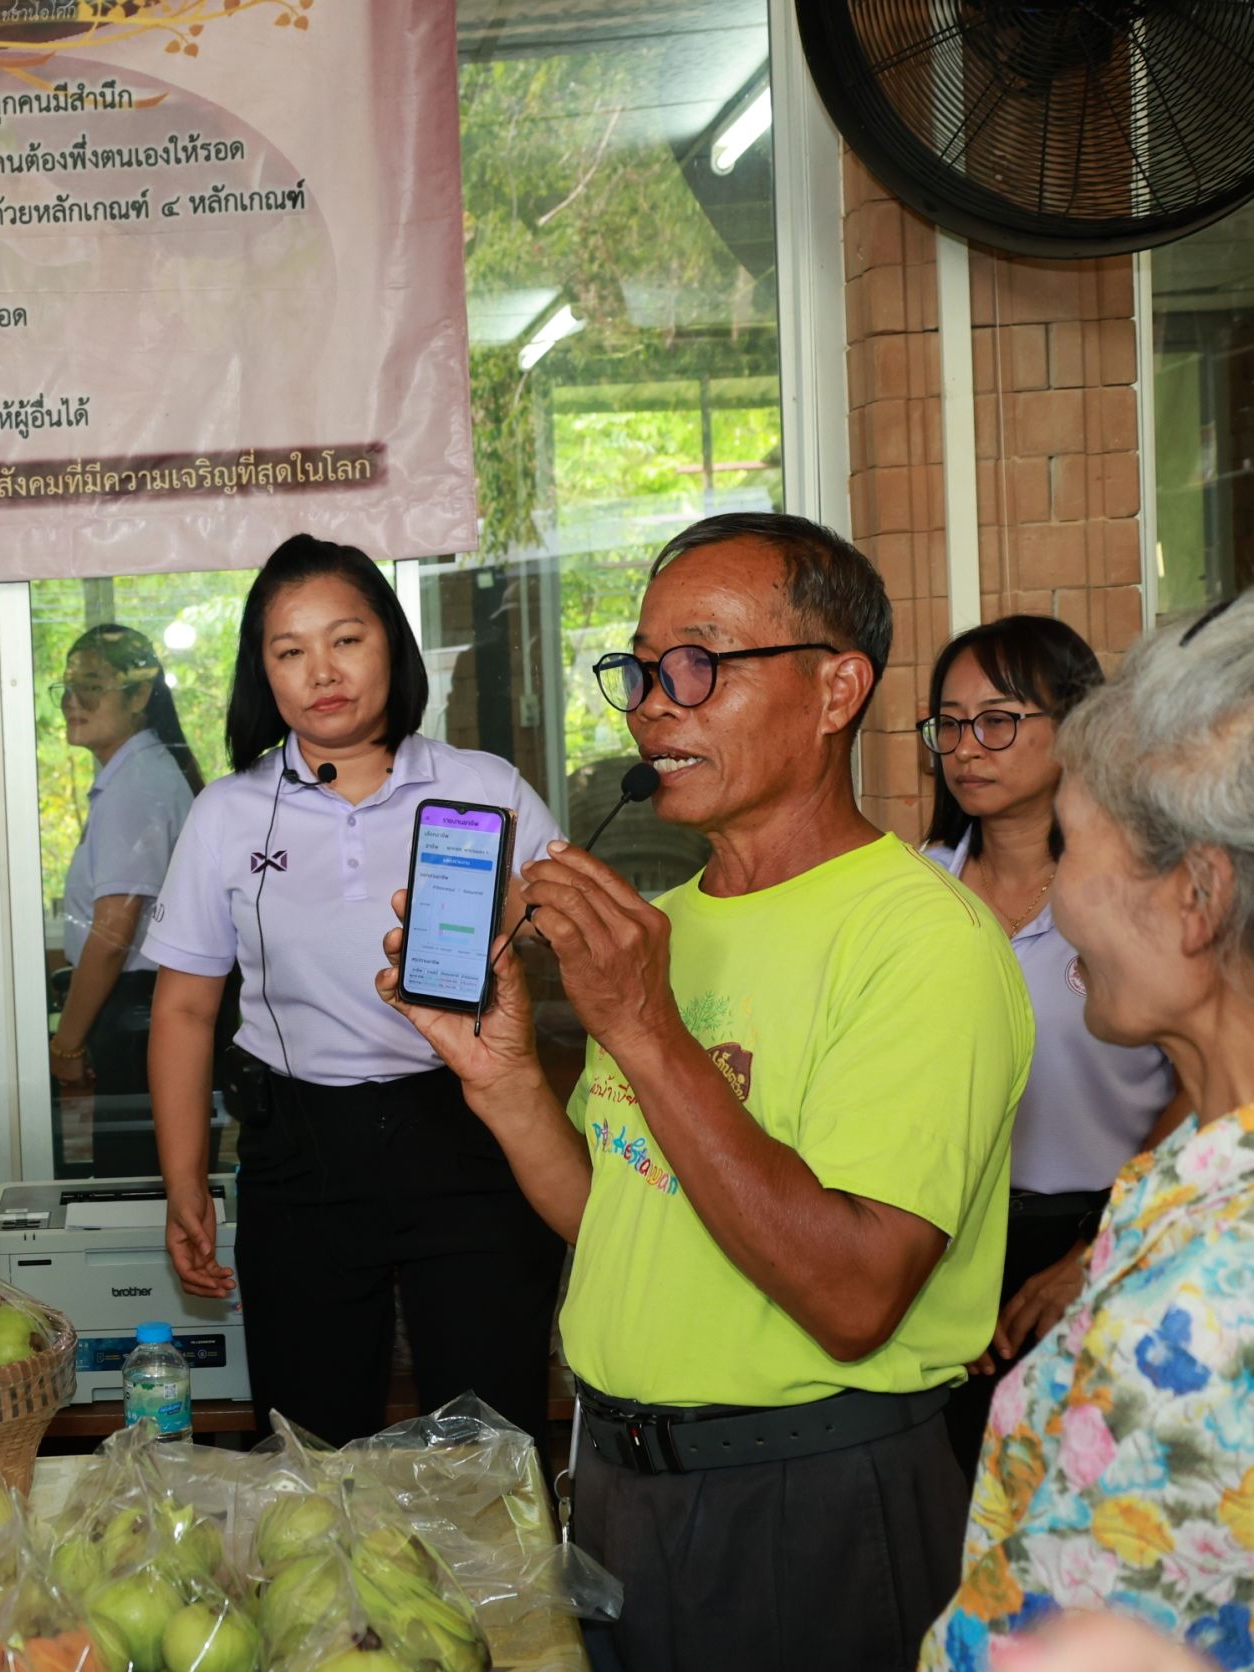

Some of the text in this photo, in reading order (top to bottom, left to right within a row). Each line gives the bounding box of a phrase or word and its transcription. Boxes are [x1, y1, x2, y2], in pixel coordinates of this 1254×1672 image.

[161, 196, 181, 217] ๔
[189, 178, 306, 214] หลักเกณฑ์
[112, 1287, 152, 1298] brother
